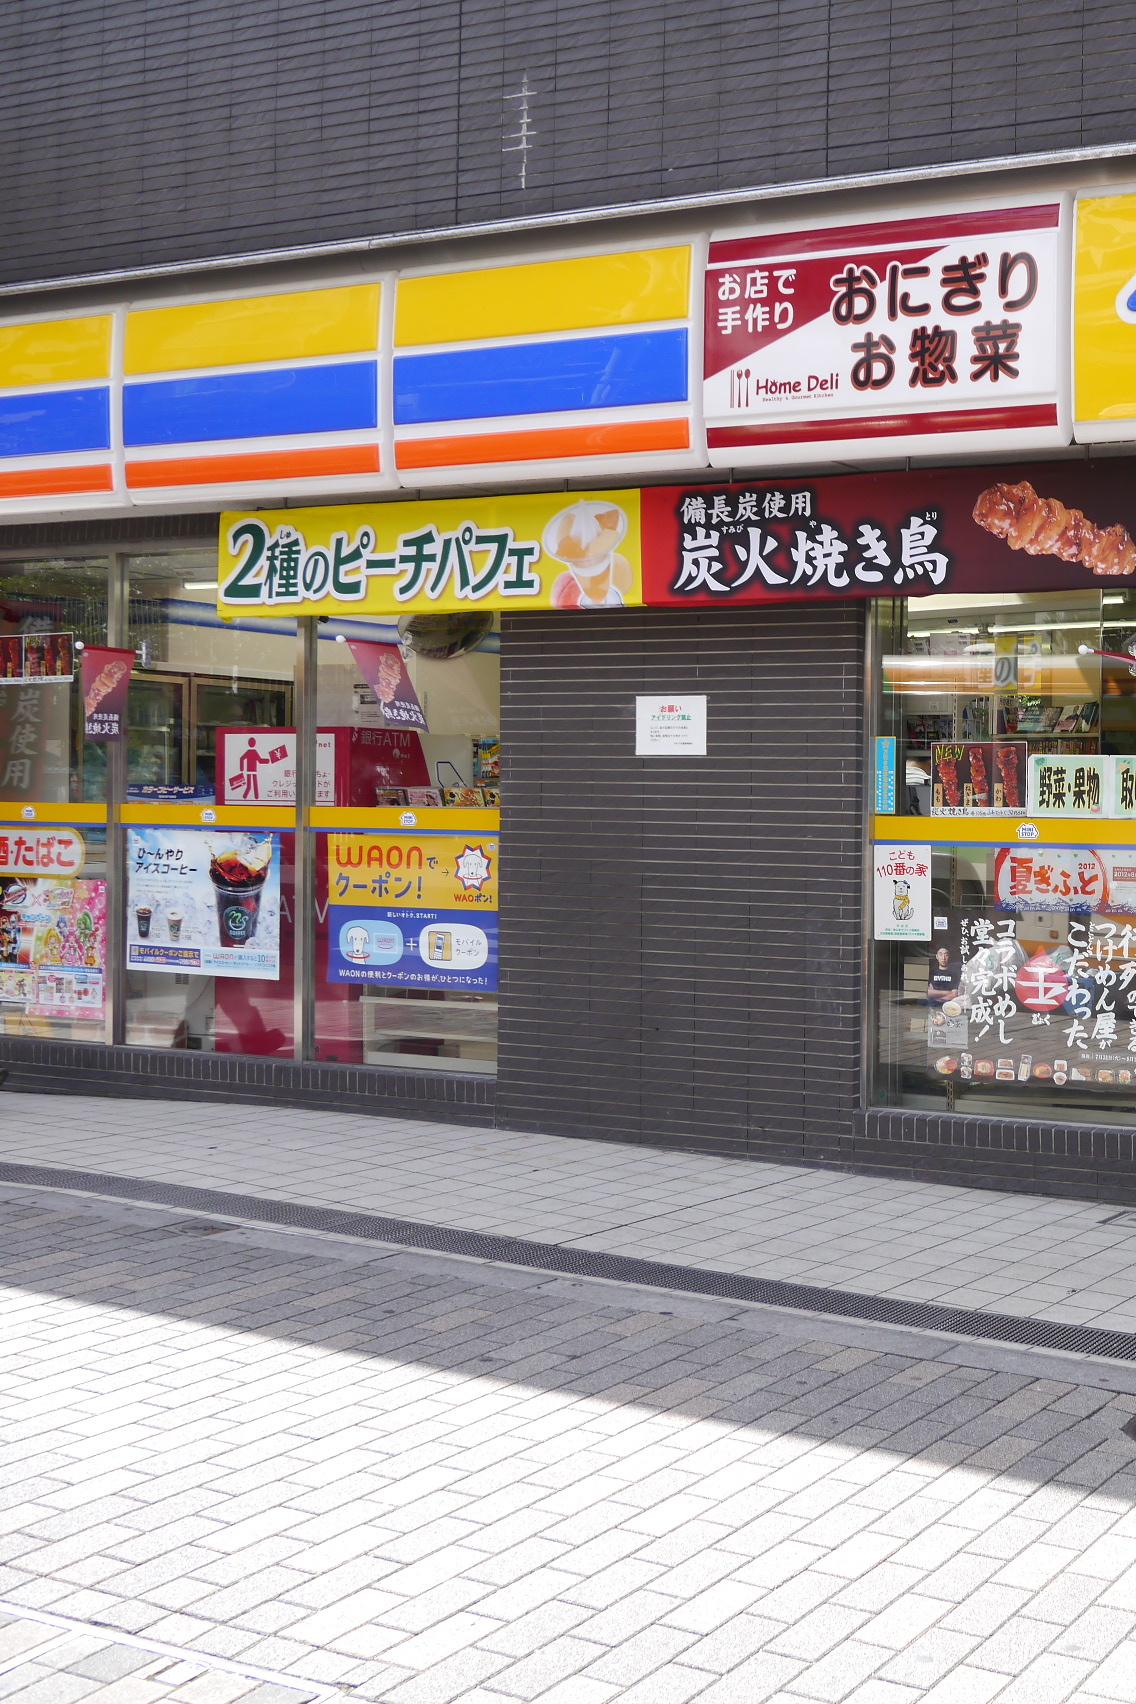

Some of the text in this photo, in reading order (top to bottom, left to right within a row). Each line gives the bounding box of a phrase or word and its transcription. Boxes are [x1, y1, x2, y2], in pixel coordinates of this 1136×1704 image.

[717, 268, 797, 301] お店で
[831, 251, 1038, 324] おにぎり
[717, 304, 795, 335] 手作り
[850, 319, 1022, 391] お惣菜
[756, 372, 839, 395] Home Deli
[680, 490, 812, 525] 備長炭使用
[223, 522, 537, 600] 2種のピーチパフェ
[674, 515, 949, 592] 炭火焼き鳥
[361, 730, 410, 747] 銀行ATM
[935, 744, 964, 765] NEW
[1039, 766, 1100, 809] 野菜・果物
[135, 861, 198, 876] アイスコーヒー
[876, 862, 929, 878] 110番の家
[889, 850, 915, 861] こども
[335, 871, 422, 900] クーポン!
[1009, 856, 1099, 896] 夏ぎふと
[455, 938, 482, 947] モバイル
[455, 948, 480, 957] クーポン
[992, 918, 1018, 1045] コラボめし
[1063, 921, 1092, 1050] こだわった
[1091, 922, 1118, 1051] つけめん屋が
